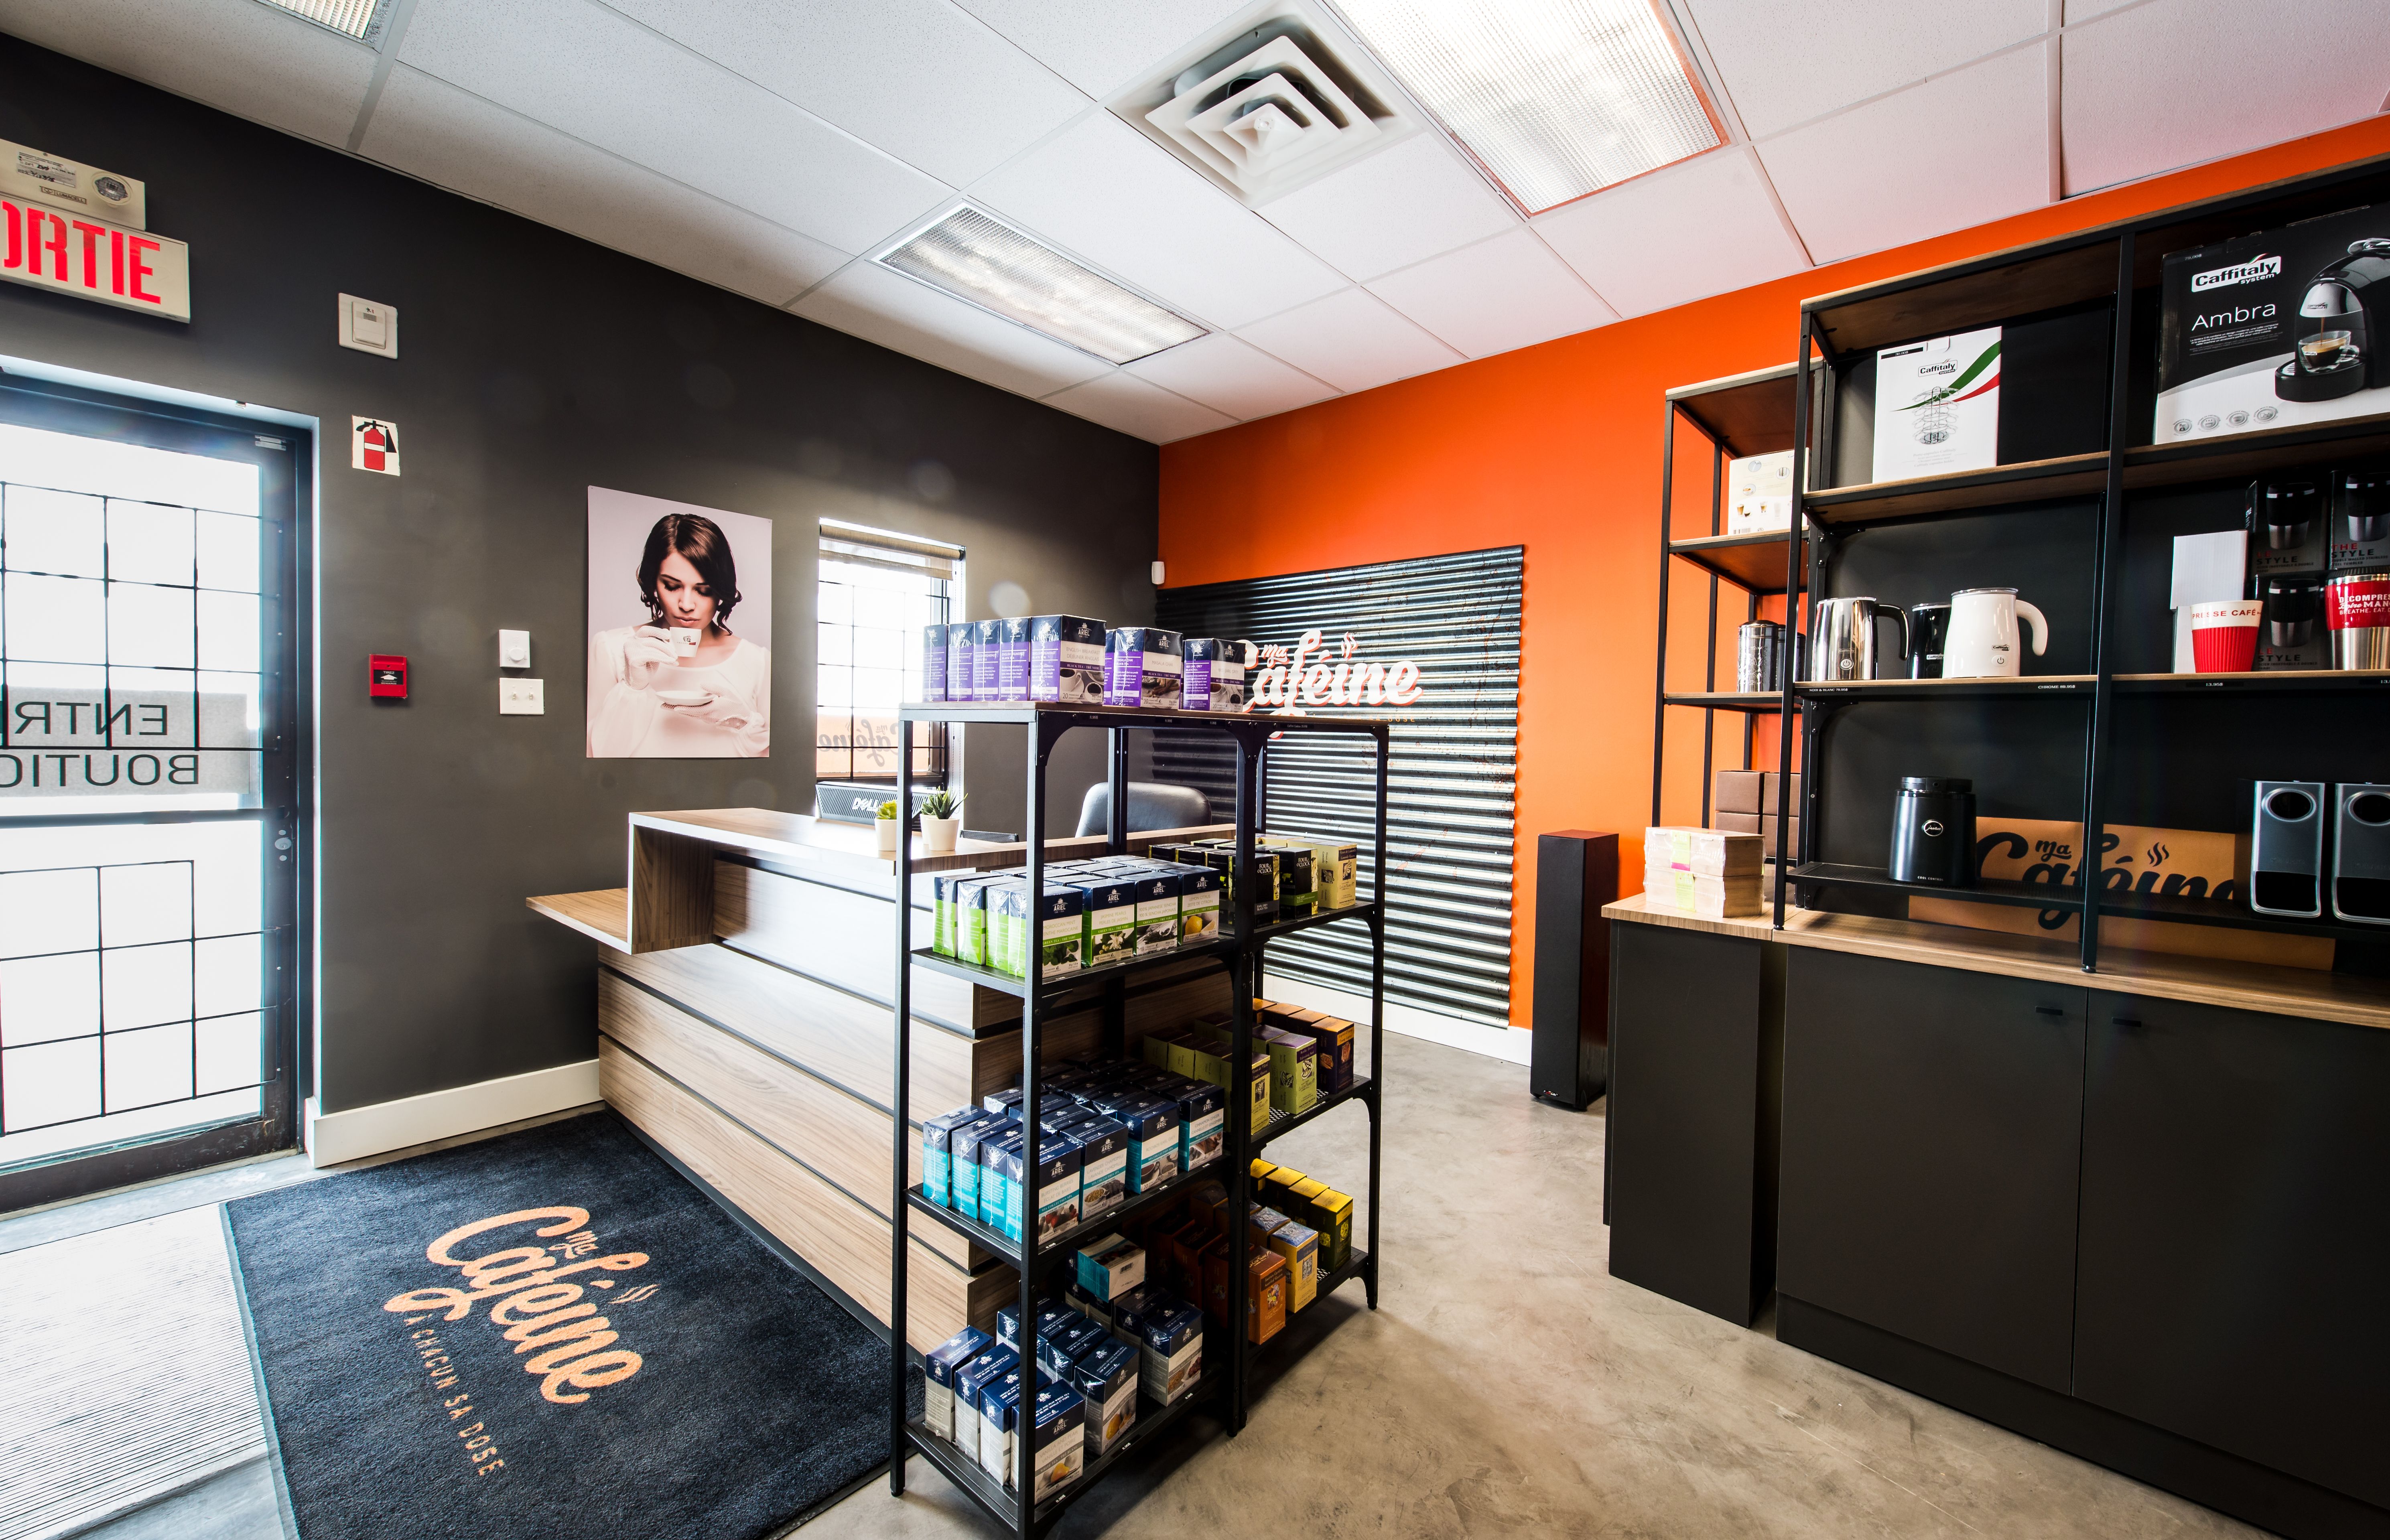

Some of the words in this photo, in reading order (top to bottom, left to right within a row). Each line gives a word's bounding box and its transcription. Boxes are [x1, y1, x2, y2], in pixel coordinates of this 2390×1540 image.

[56, 191, 85, 203] LUMACELL
[2195, 262, 2277, 286] Caffitaly
[2241, 273, 2274, 284] system
[2191, 304, 2276, 331] Ambra
[1921, 363, 1955, 374] Caffitaly
[2256, 556, 2298, 565] STYLE
[2332, 549, 2374, 558] STYLE
[2192, 610, 2227, 620] PRESSE
[2035, 839, 2071, 860] ma
[1102, 1144, 1113, 1152] ARIEL
[1052, 1167, 1064, 1176] ARIEL
[1087, 1165, 1104, 1175] LAVENDER
[1105, 1154, 1123, 1166] CHAMOMILE
[1088, 1171, 1104, 1180] LAVANDE
[1105, 1161, 1123, 1172] CAMOMILLE
[1041, 1187, 1059, 1197] BURSTING
[1060, 1179, 1073, 1189] BERRIES
[1044, 1194, 1056, 1203] ÉCLAT
[1062, 1186, 1071, 1194] BAIES
[1048, 1197, 1066, 1209] COLLECTION
[548, 1230, 599, 1259] ma
[383, 1206, 650, 1404] Caféine
[404, 1313, 425, 1327] À
[410, 1329, 459, 1390] CHACUN
[444, 1393, 473, 1420] SA
[1054, 1423, 1066, 1434] ARIEL
[458, 1422, 504, 1477] DOSE
[1040, 1444, 1056, 1458] VANILLA
[1068, 1430, 1078, 1440] PEAR
[1042, 1450, 1057, 1463] VANILLE
[1065, 1437, 1076, 1447] POIRE
